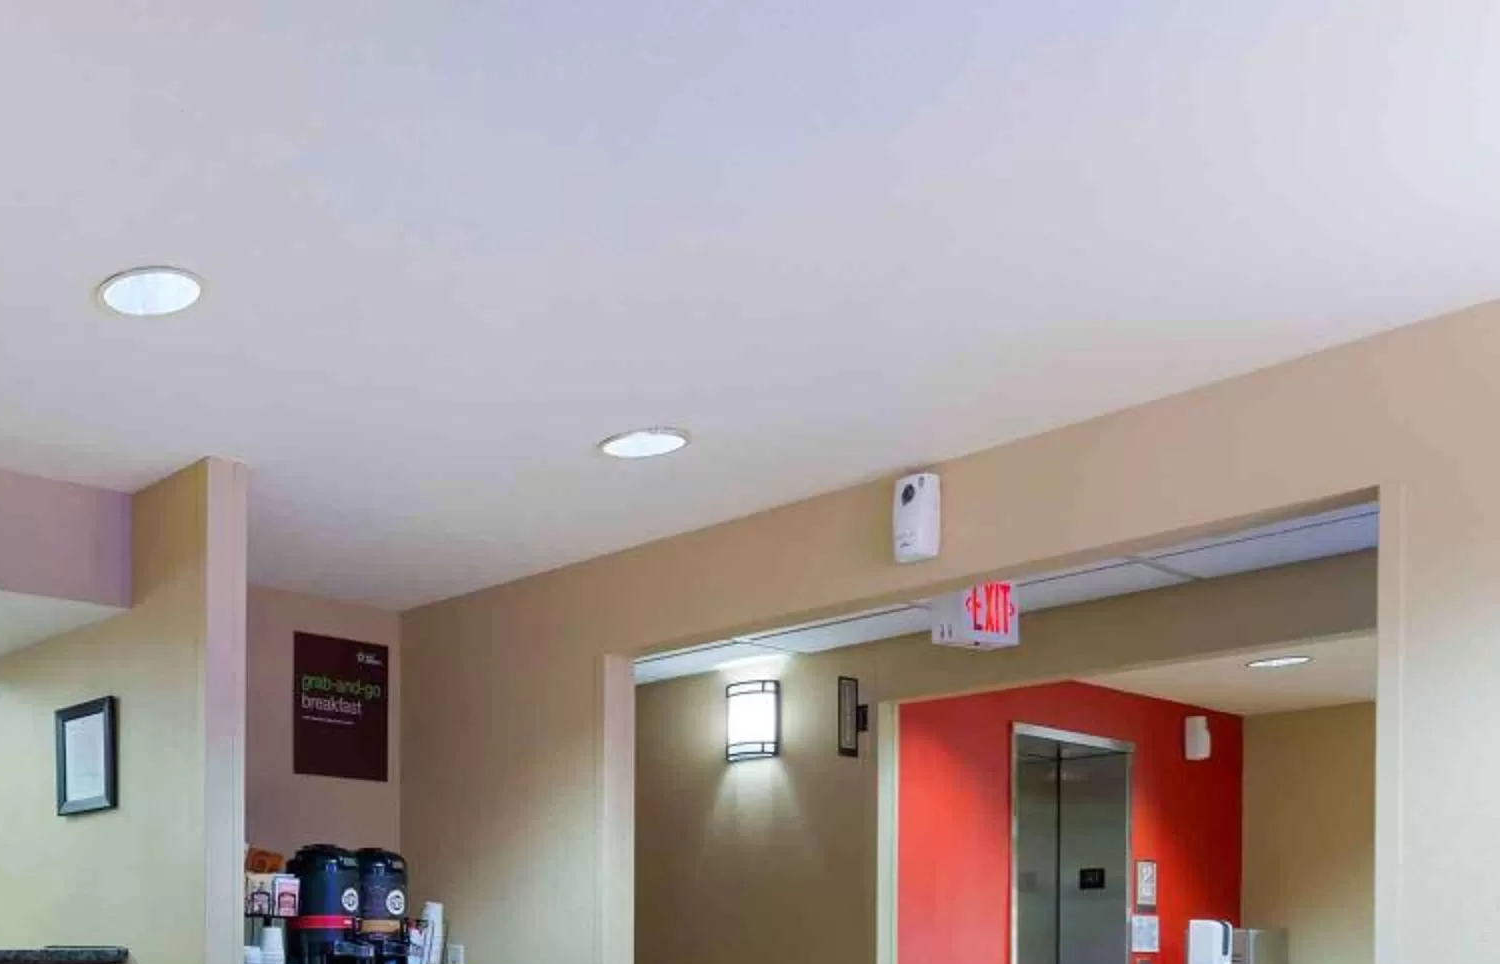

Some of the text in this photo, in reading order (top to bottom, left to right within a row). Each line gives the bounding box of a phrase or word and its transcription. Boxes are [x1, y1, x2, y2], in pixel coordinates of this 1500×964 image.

[972, 583, 1011, 635] EXIT
[302, 674, 381, 700] grab-and-go
[301, 692, 362, 714] breakfast
